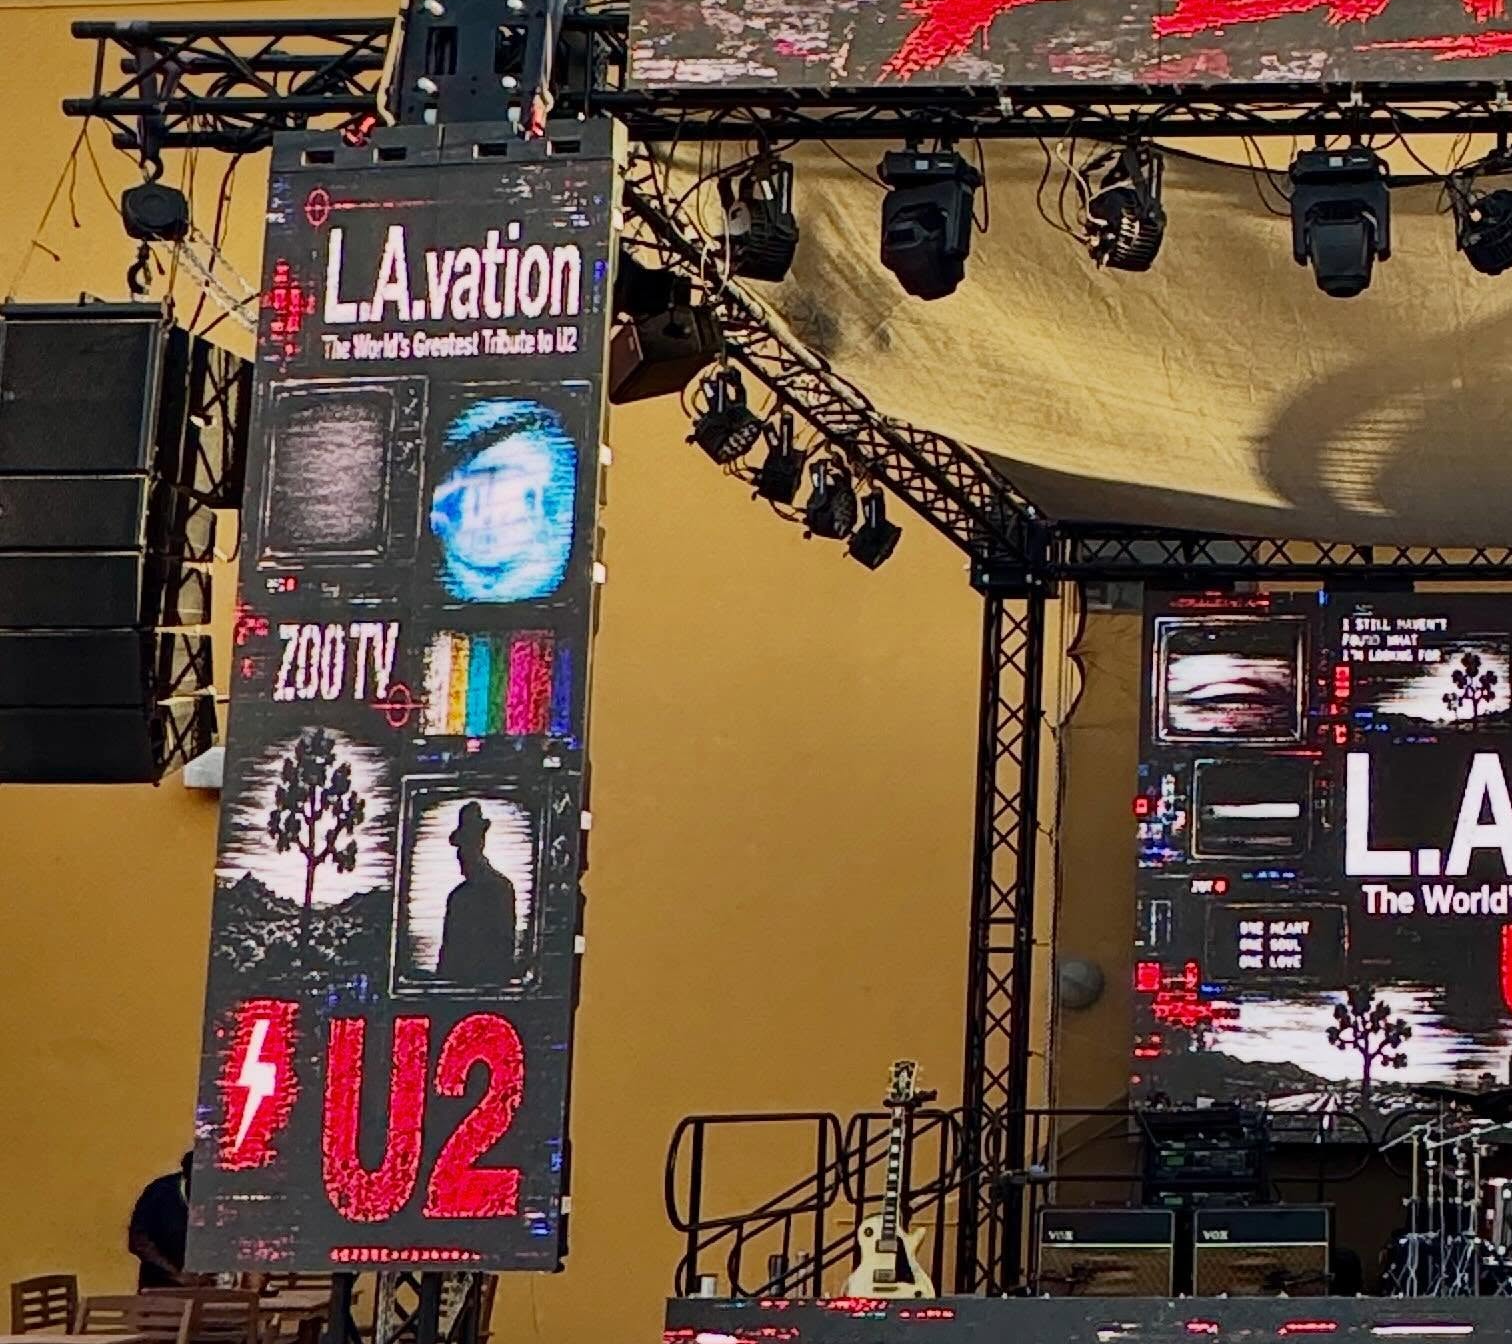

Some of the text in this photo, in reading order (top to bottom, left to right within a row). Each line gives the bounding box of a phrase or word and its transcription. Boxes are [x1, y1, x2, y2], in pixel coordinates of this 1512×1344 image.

[324, 222, 582, 324] L.A.vation
[321, 326, 578, 360] The World's Greatest Tribute to U2
[1355, 618, 1392, 631] STILL
[273, 621, 400, 702] ZOO TV
[1362, 884, 1415, 915] The
[321, 1010, 527, 1224] U2
[1202, 1230, 1229, 1241] VOX
